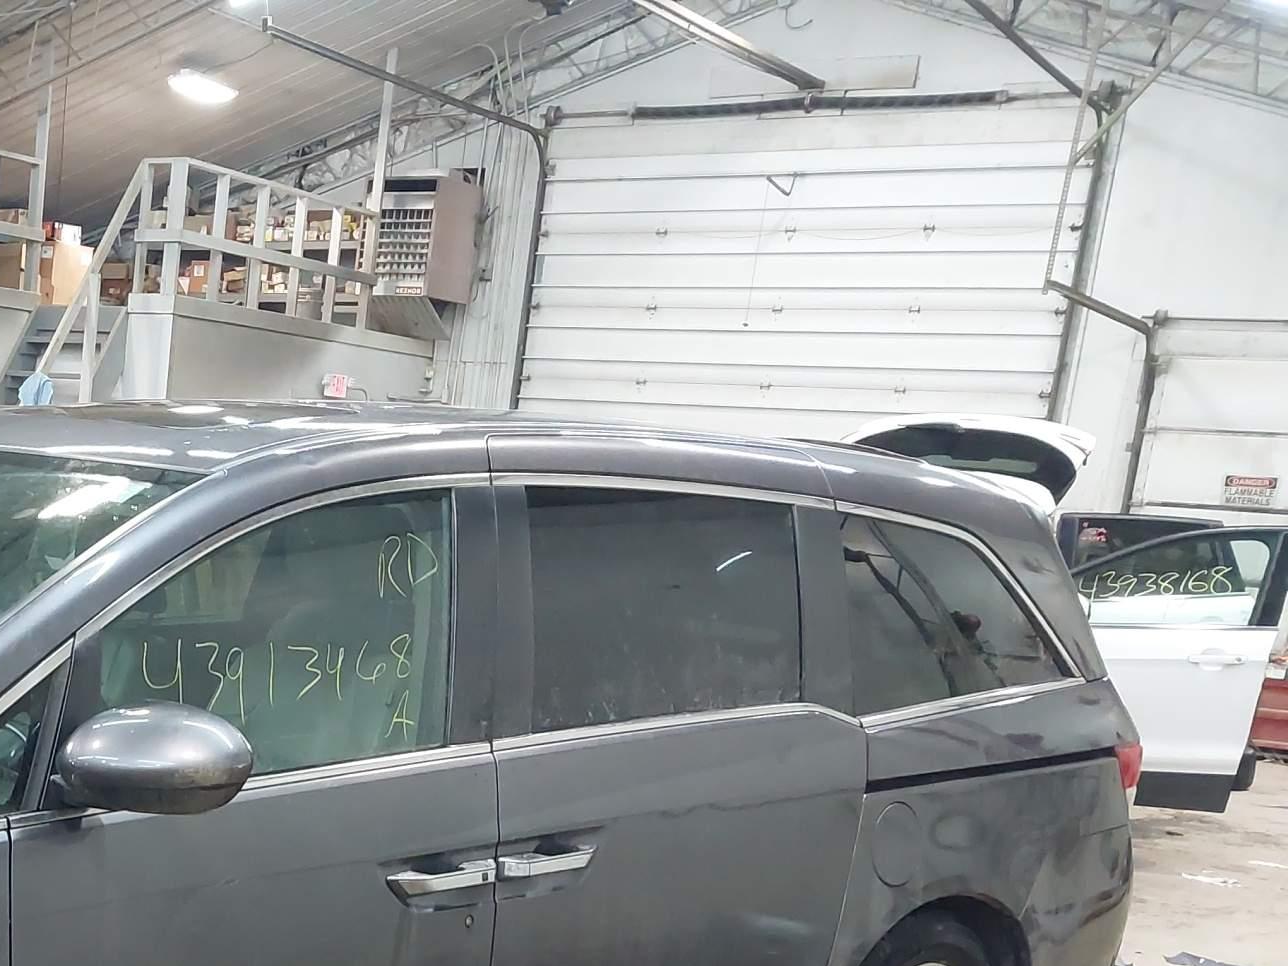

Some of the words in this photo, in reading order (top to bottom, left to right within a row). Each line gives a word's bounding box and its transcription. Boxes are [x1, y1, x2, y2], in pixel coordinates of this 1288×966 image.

[1224, 488, 1276, 498] FLAMMABLE
[1224, 496, 1272, 507] MATERIALS
[377, 532, 439, 598] RD
[1078, 565, 1233, 603] 43938168
[142, 633, 412, 726] 43913468
[383, 688, 416, 742] A
